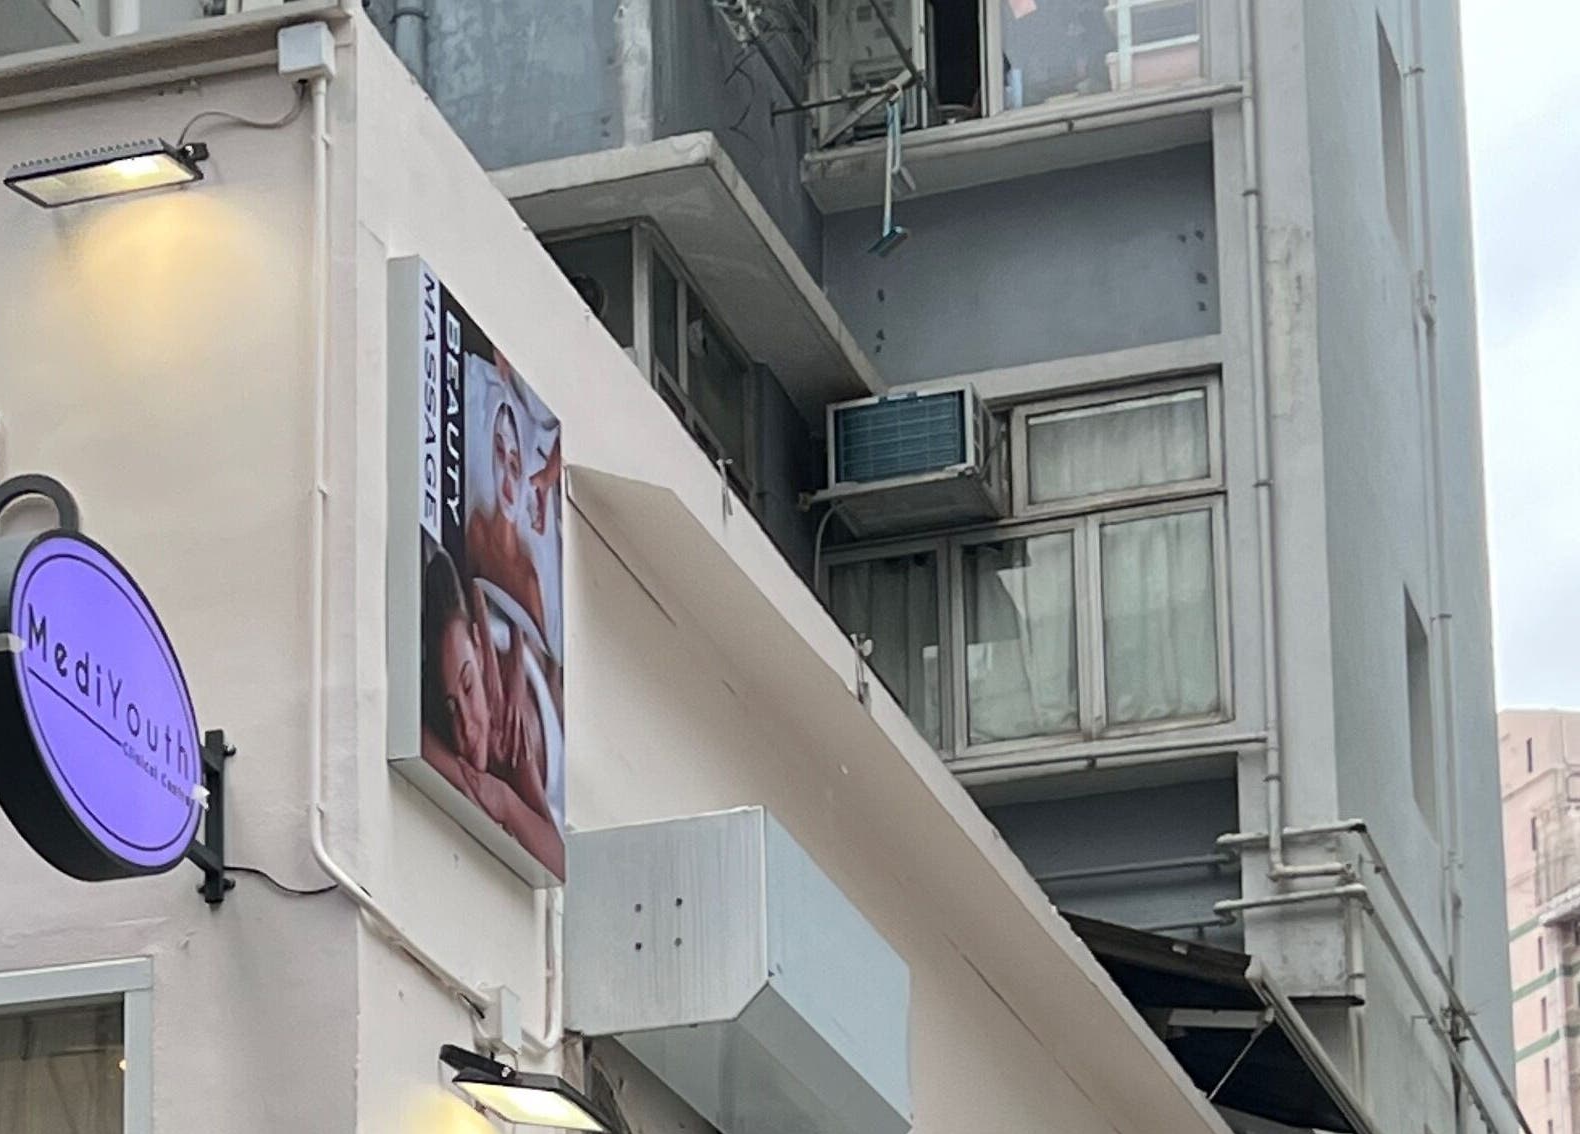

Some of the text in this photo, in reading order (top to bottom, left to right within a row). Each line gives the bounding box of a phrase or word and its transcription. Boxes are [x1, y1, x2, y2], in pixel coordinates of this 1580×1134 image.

[424, 271, 439, 528] MASSAGE
[446, 309, 462, 528] BEAUTY
[27, 602, 190, 781] MediYouth
